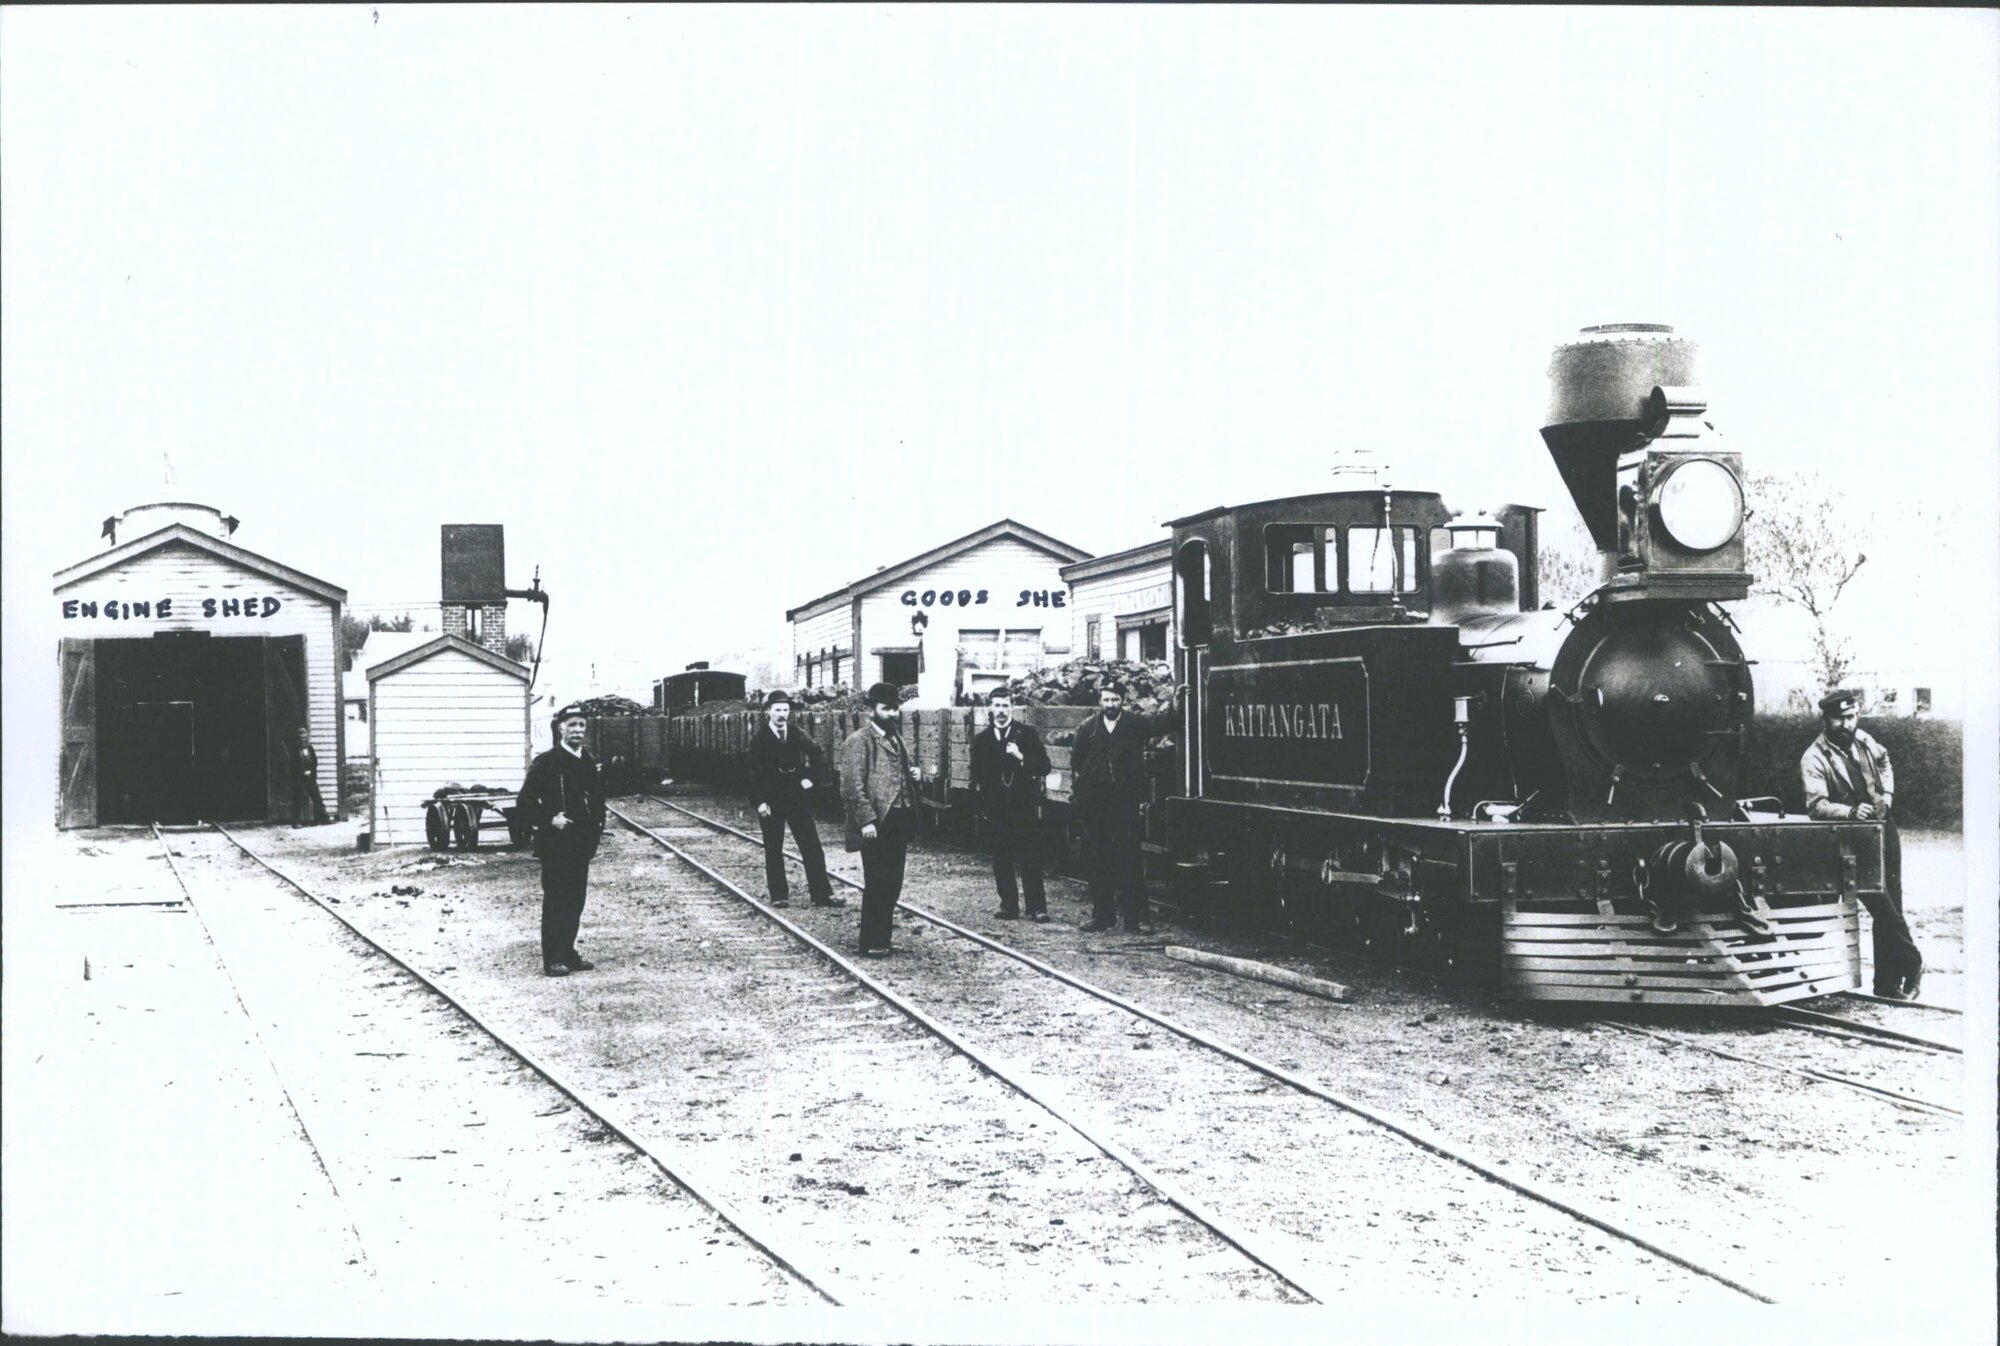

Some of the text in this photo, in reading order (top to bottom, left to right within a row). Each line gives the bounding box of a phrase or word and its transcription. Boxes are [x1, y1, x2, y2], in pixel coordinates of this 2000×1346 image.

[63, 597, 281, 620] ENGINE SHED
[901, 589, 1066, 608] GOODS SHE
[1225, 703, 1343, 739] KAITANGATA
